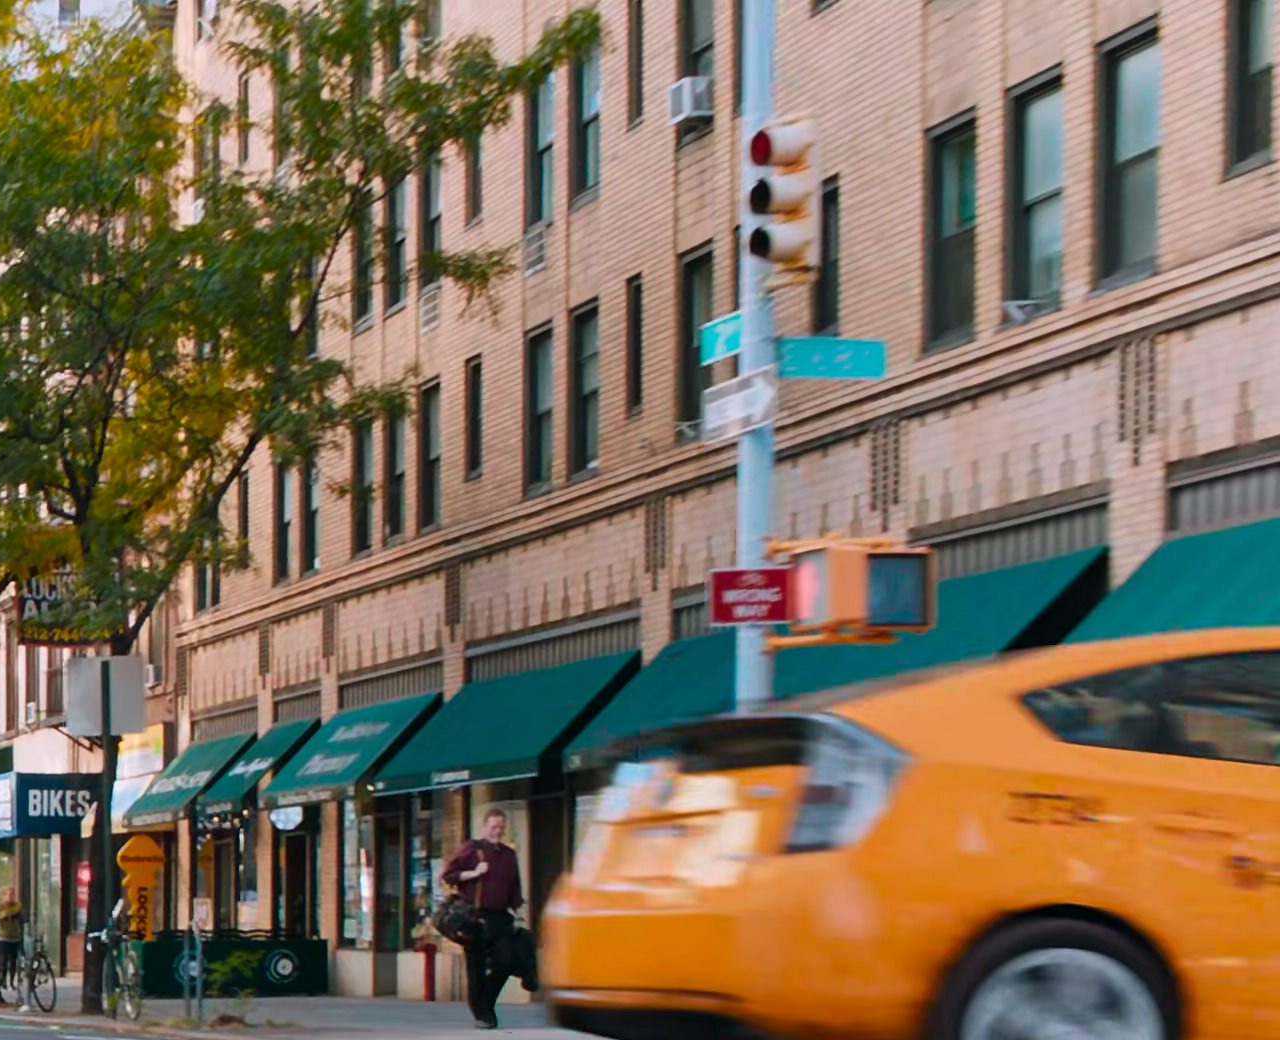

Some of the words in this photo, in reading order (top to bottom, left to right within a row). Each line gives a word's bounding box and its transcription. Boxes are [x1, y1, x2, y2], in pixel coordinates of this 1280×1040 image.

[721, 587, 783, 604] WRONG
[732, 603, 773, 618] WAY
[28, 789, 90, 817] BIKES
